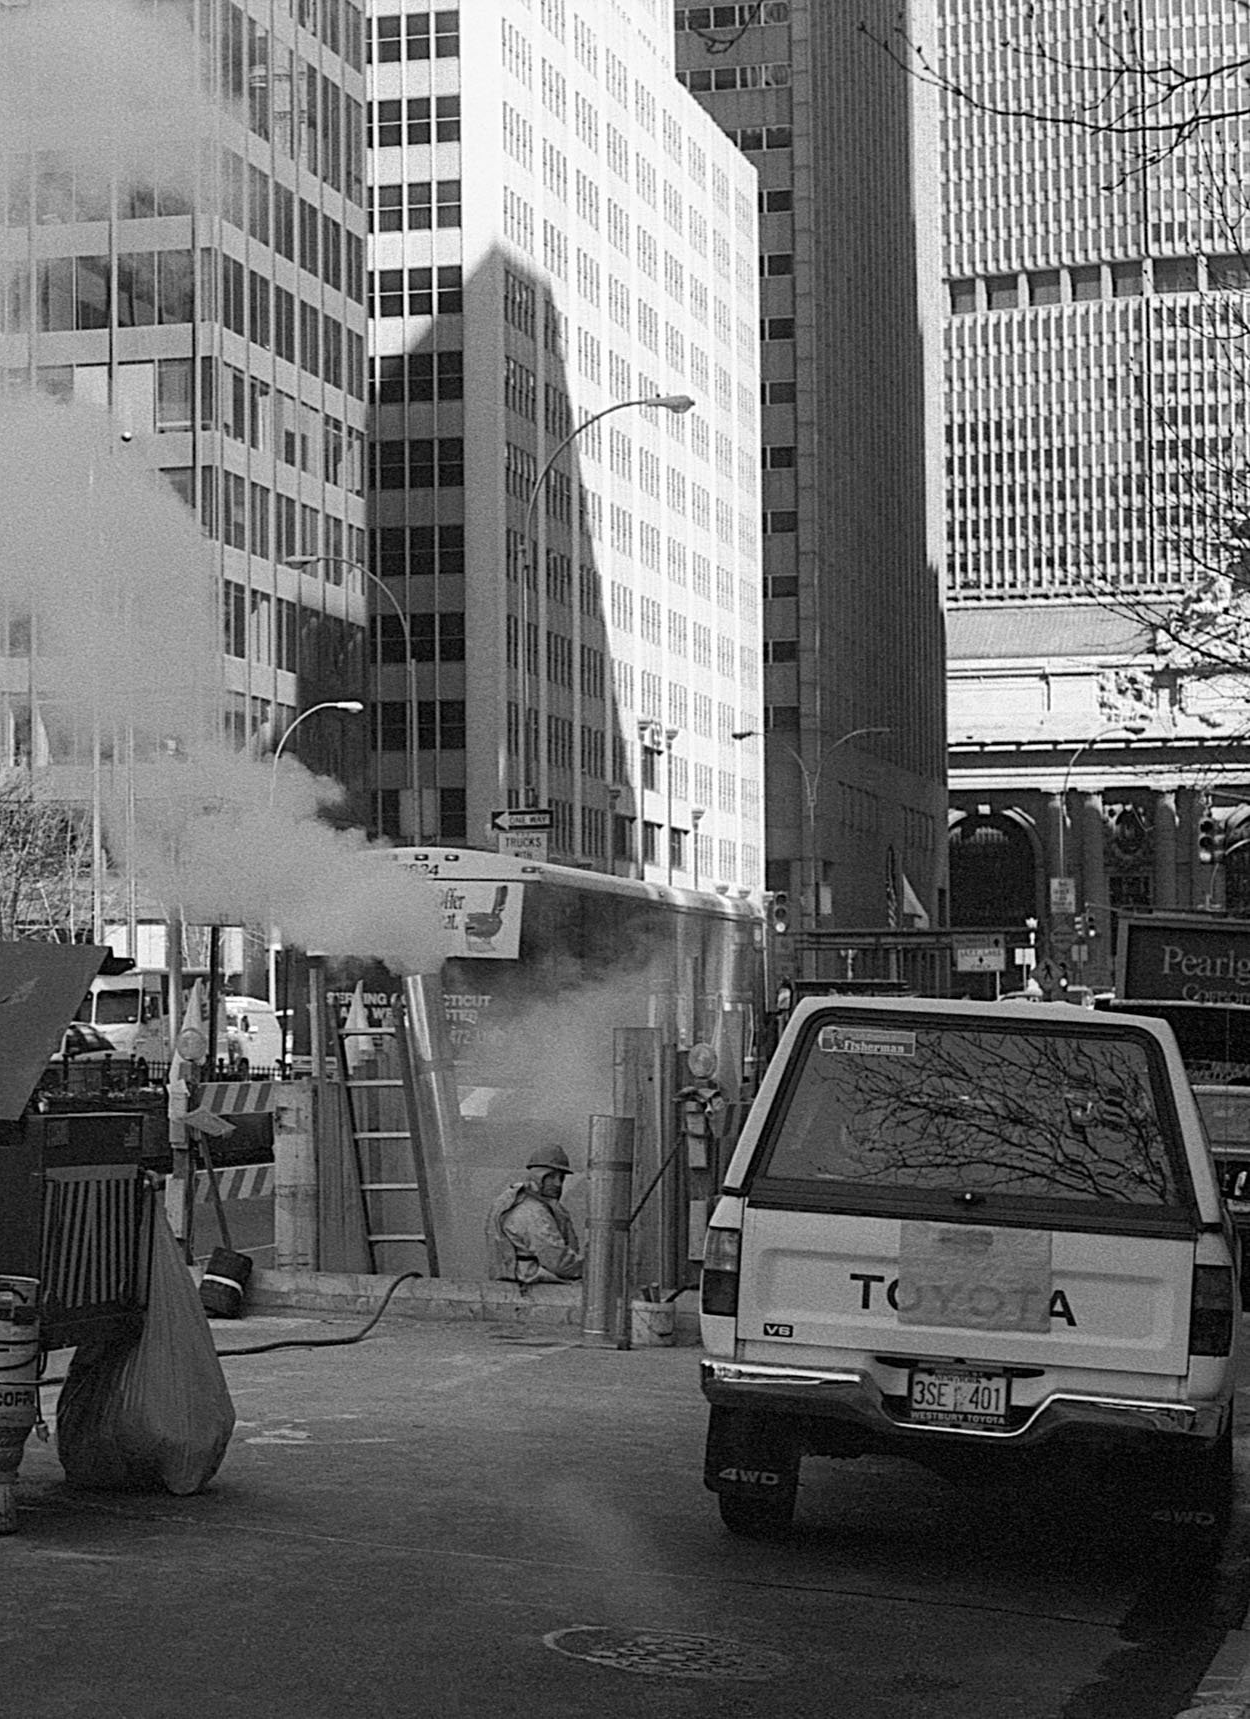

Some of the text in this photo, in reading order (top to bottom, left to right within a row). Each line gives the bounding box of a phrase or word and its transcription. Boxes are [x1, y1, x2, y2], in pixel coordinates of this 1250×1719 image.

[509, 814, 548, 825] ONE WAY
[505, 836, 542, 849] TRUCKS
[765, 1324, 791, 1336] V6
[913, 1380, 1000, 1411] 3SE 401
[910, 1410, 1006, 1425] WESTBURY TOYOTA
[718, 1467, 779, 1485] 4WD
[1150, 1510, 1215, 1526] 4WD
